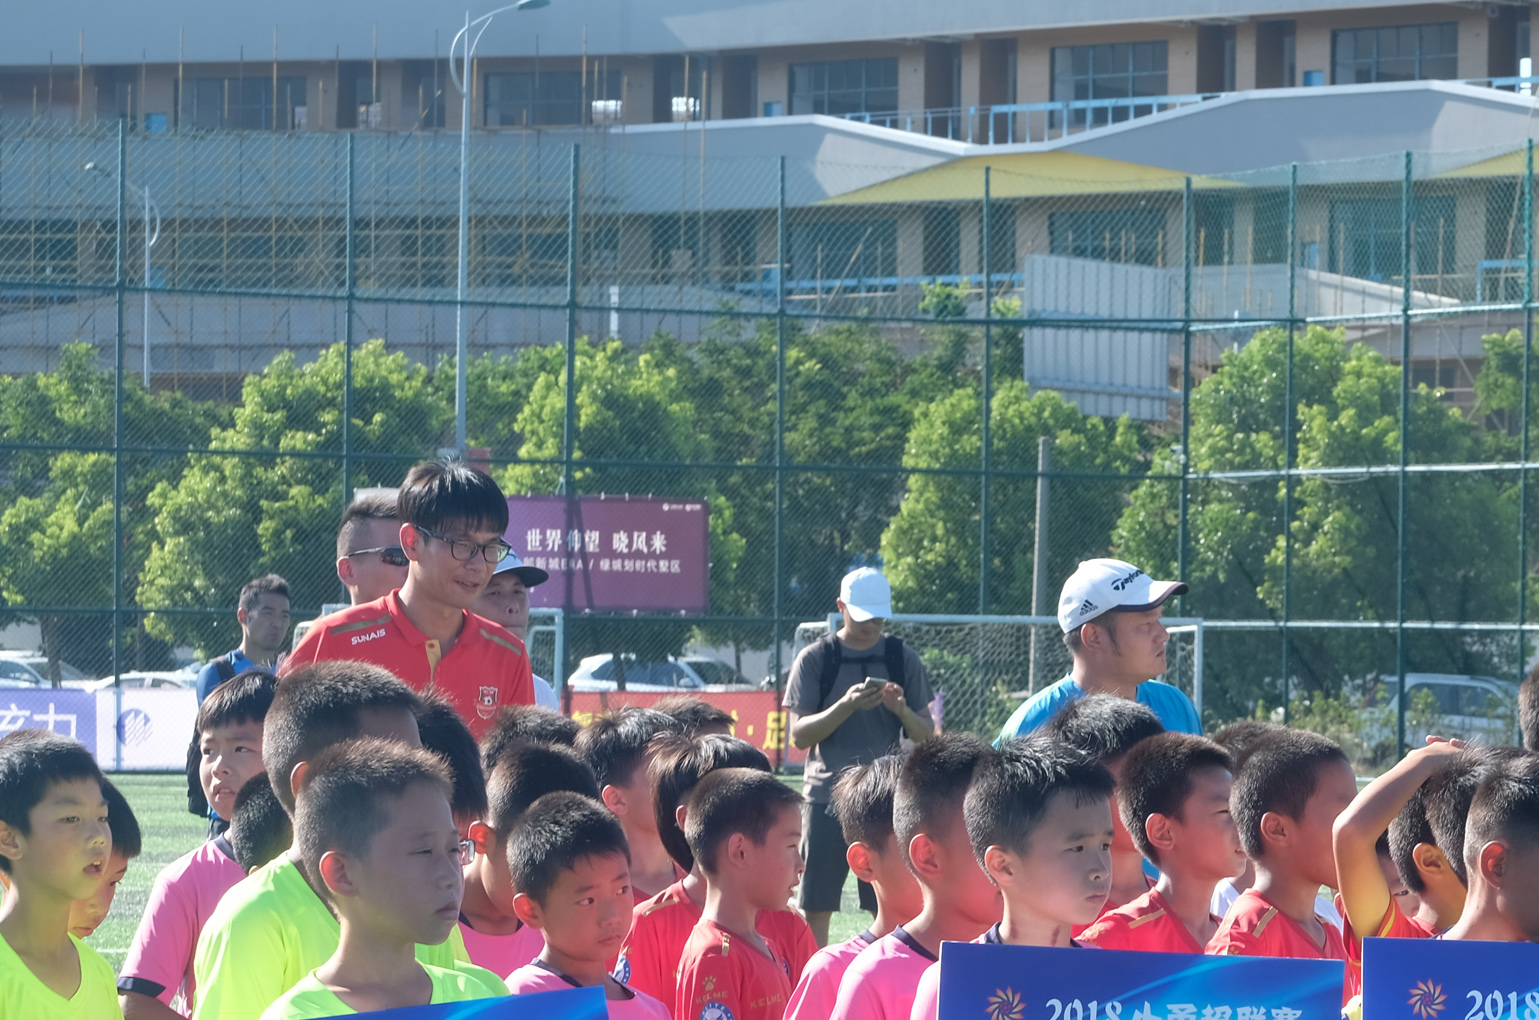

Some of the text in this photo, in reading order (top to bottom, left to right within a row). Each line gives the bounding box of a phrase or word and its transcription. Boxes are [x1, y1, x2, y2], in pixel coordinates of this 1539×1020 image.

[526, 528, 667, 554] 世界仰望 晓风来
[351, 628, 386, 645] SUNAIS
